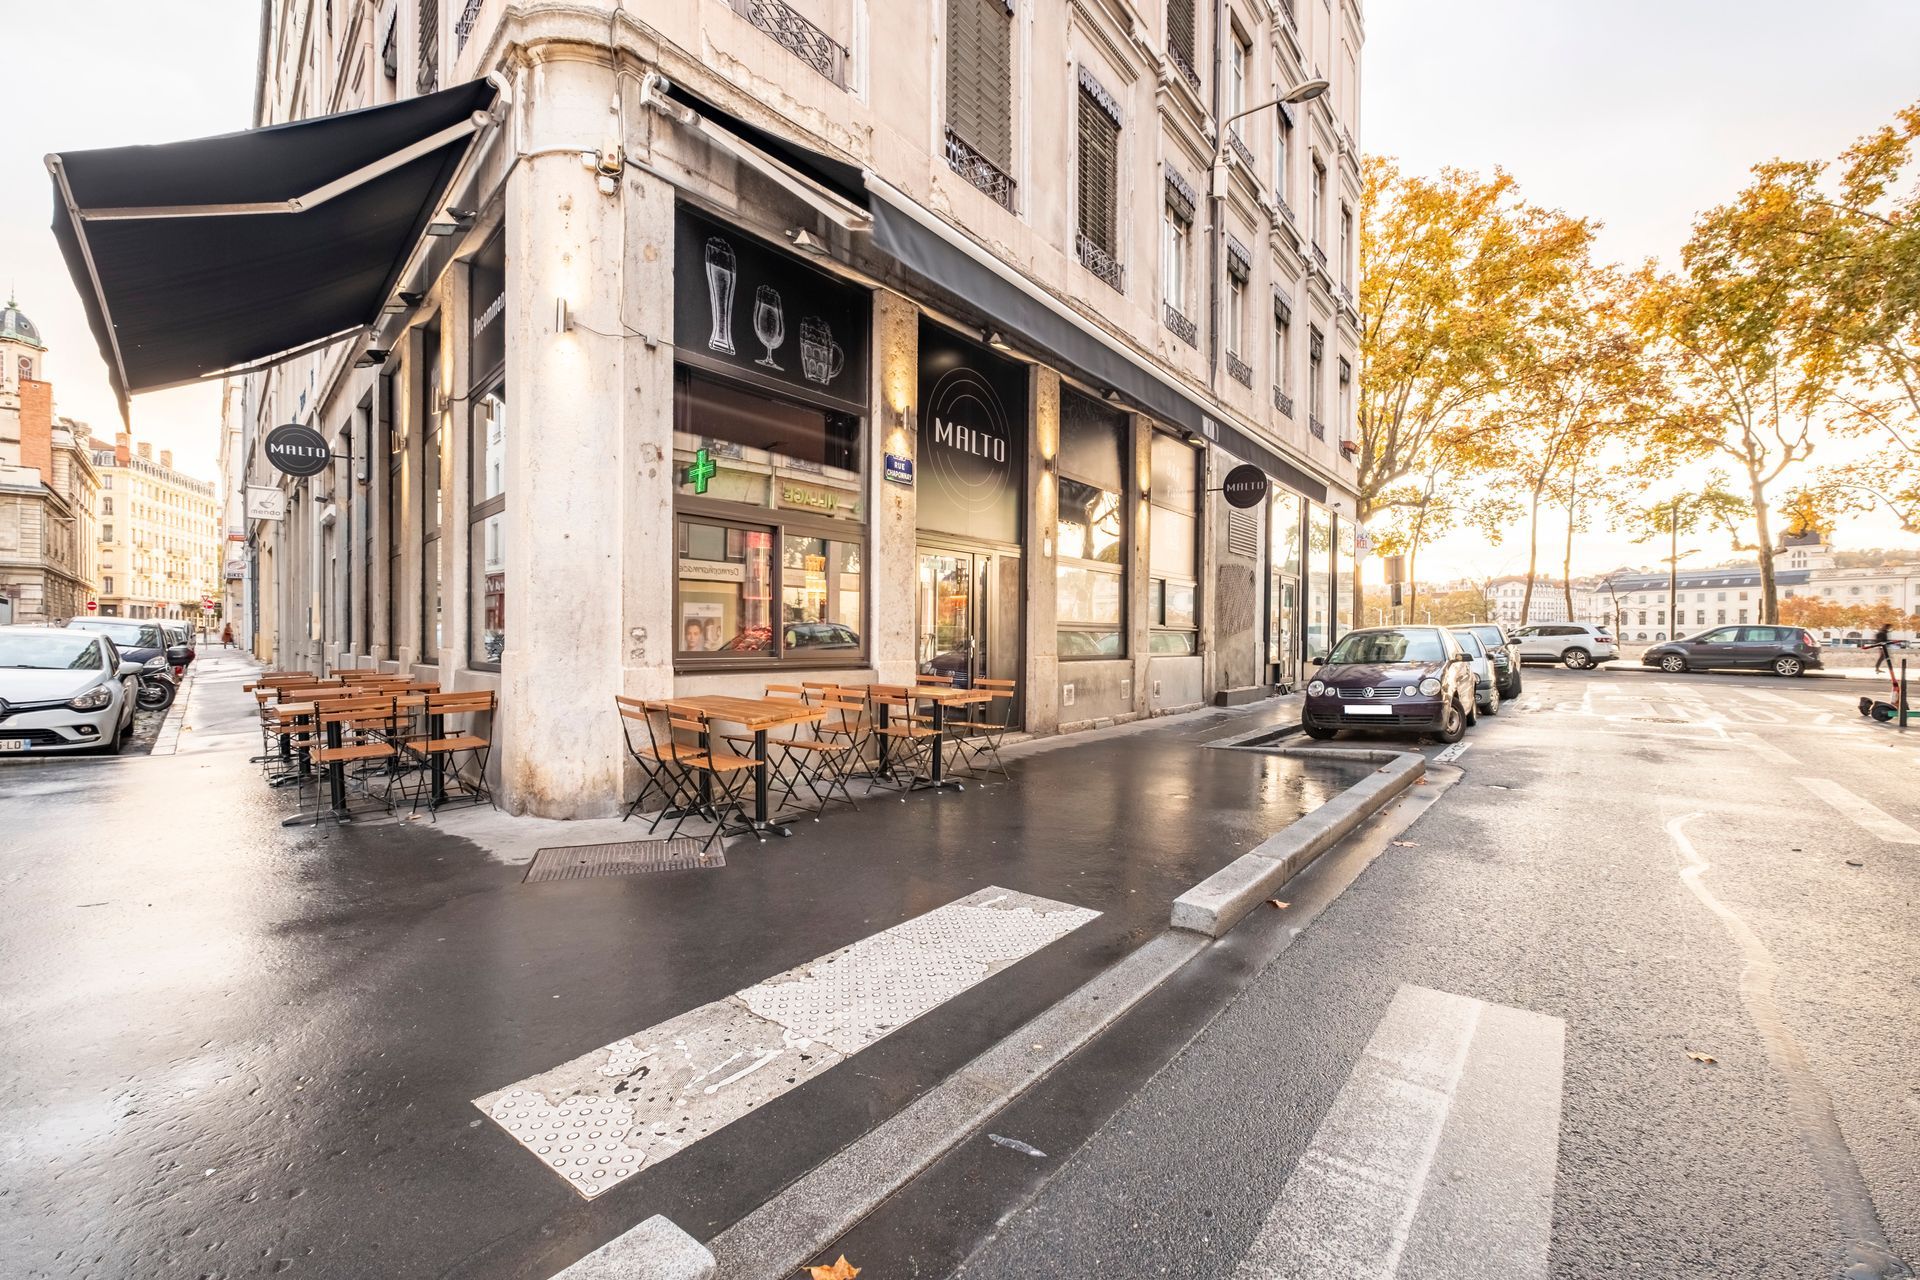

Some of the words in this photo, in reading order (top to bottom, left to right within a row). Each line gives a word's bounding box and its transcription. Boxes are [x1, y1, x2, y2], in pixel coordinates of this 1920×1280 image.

[935, 417, 1005, 463] MALTO
[270, 443, 326, 458] MALTO
[894, 461, 906, 471] RUE
[1226, 481, 1264, 492] MALTO
